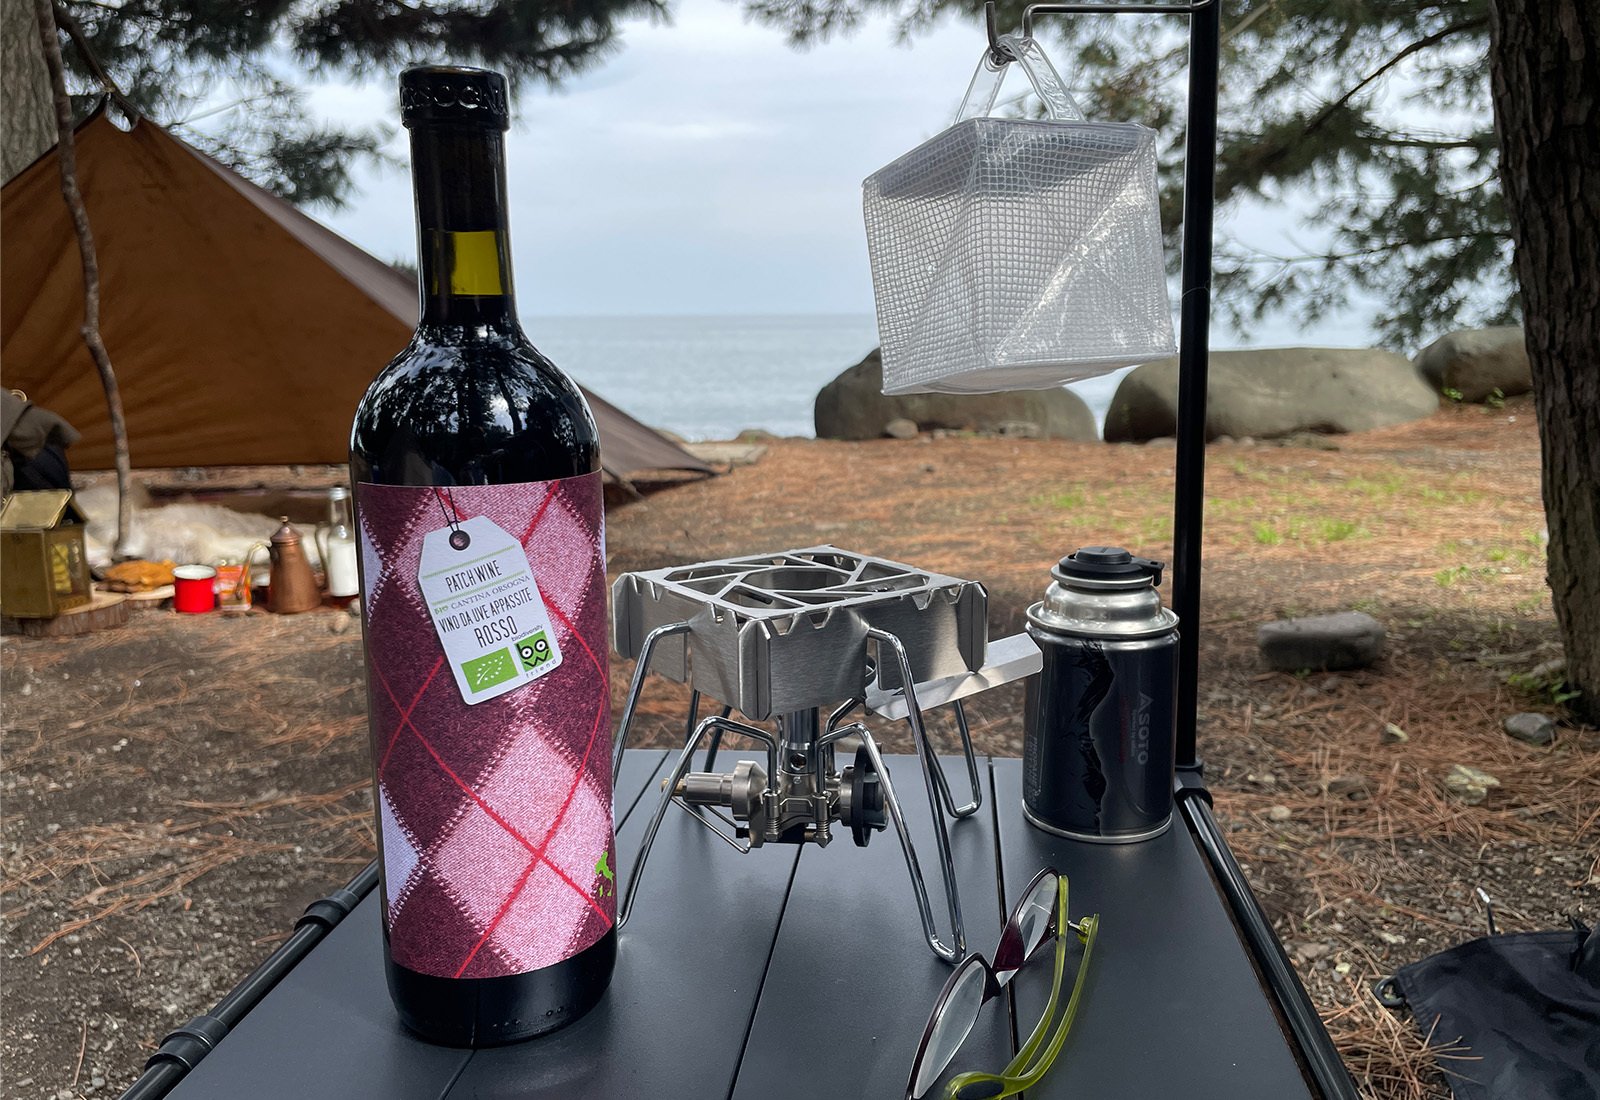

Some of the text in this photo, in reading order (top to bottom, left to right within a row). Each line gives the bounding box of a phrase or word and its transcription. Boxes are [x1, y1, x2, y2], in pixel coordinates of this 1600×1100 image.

[445, 560, 502, 593] PATCH WINE
[451, 591, 491, 610] CANTINA
[491, 575, 531, 595] ORSOGNA
[438, 587, 533, 633] VINO DA UVE APPASSITE
[474, 615, 519, 648] ROSSO
[511, 624, 543, 642] biodiversity
